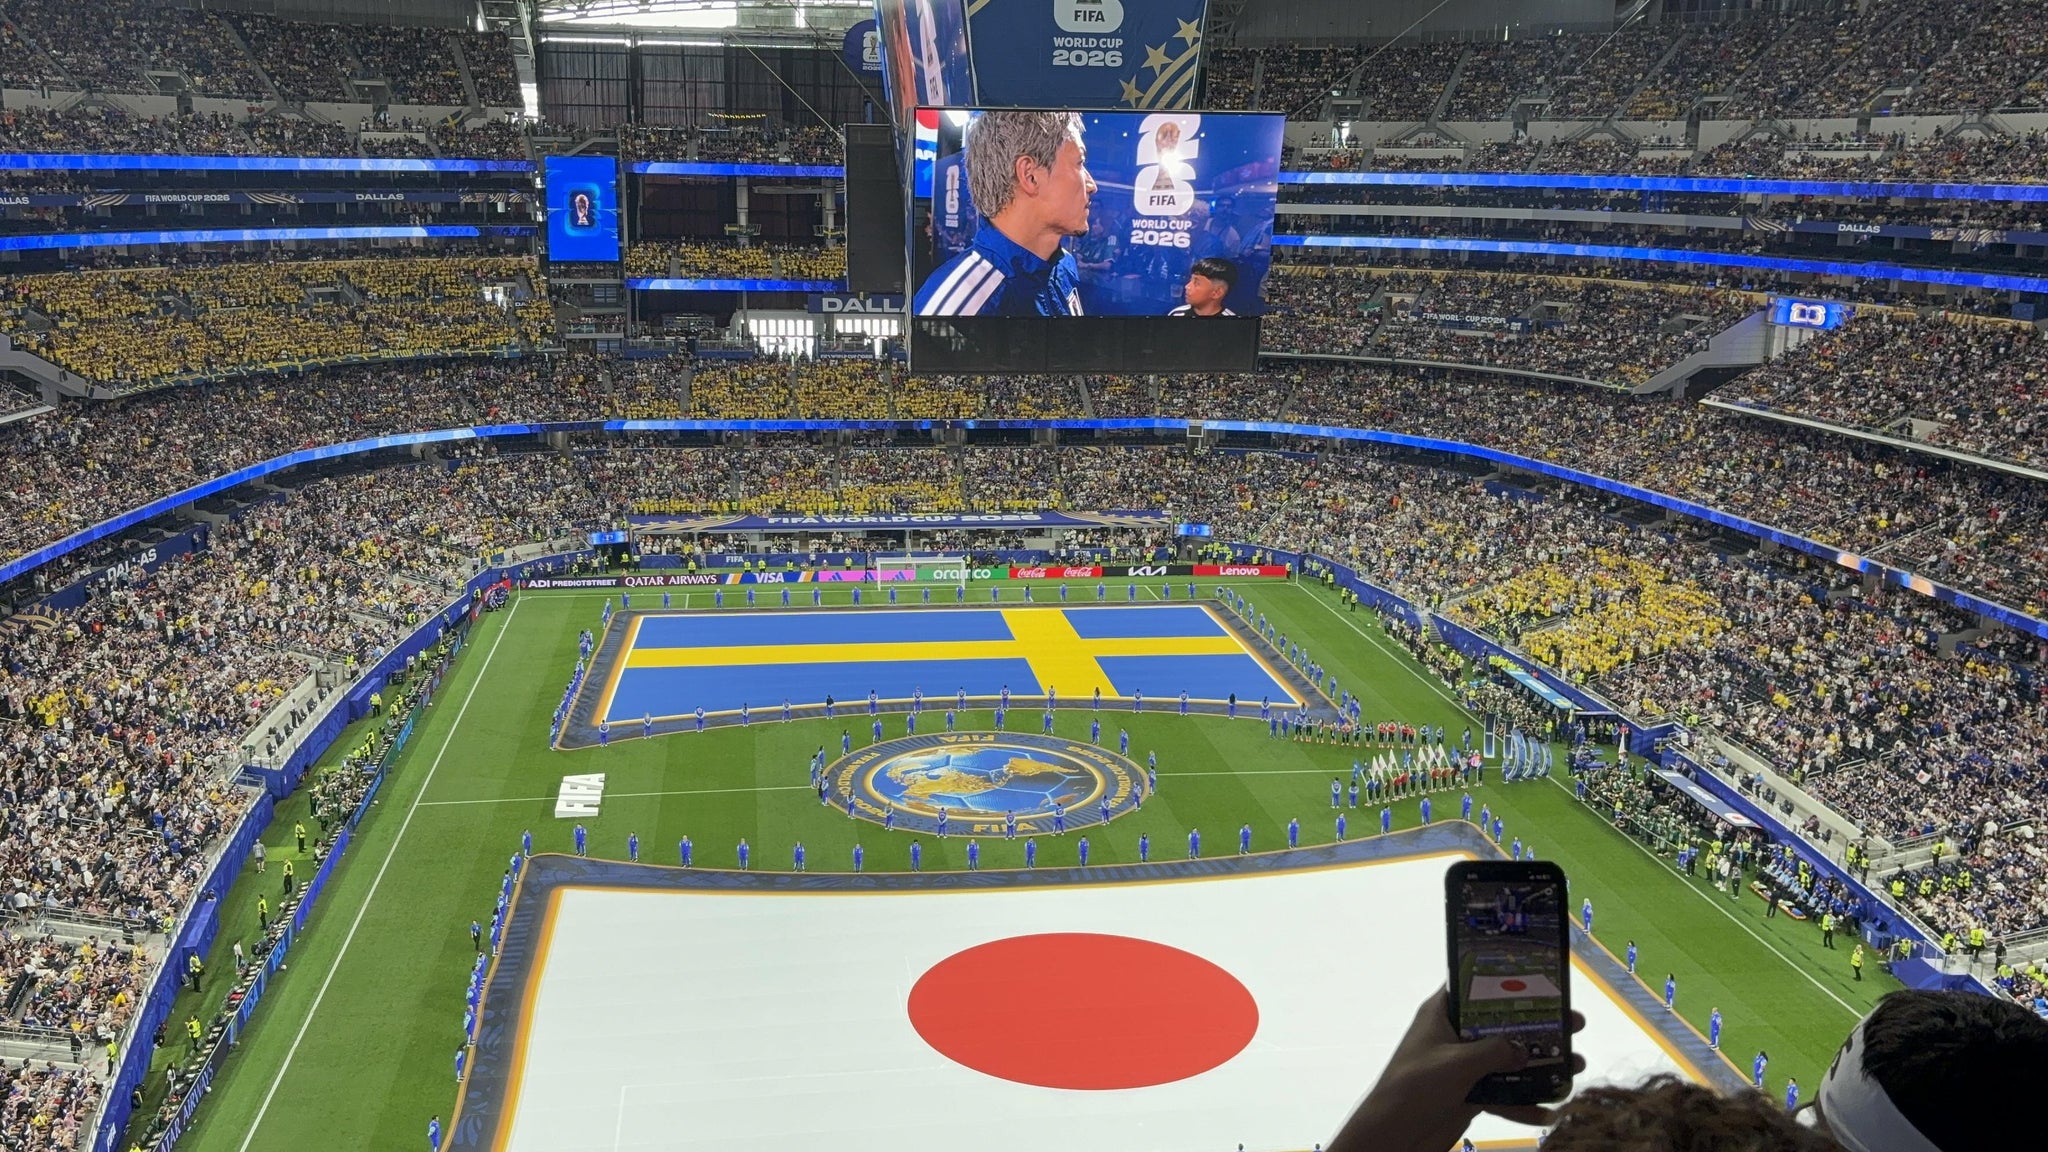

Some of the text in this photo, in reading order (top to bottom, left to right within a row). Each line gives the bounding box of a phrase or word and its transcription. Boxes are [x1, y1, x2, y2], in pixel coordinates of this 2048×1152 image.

[1074, 10, 1105, 22] FIFA
[1053, 37, 1123, 48] WORLD CUP
[1053, 50, 1123, 67] 2026
[1149, 195, 1176, 206] FIFA
[1132, 219, 1192, 231] WORLD CUP
[1838, 224, 1881, 233] DALLAS
[1130, 230, 1191, 248] 2026
[822, 515, 908, 523] WORLD
[106, 548, 157, 582] DALAS
[1220, 566, 1260, 575] Lenovo
[1128, 566, 1167, 576] KIA
[528, 579, 616, 587] ADI PREDICTSTREET
[625, 575, 717, 587] QATAR AIRWAYS
[754, 573, 784, 583] VISA
